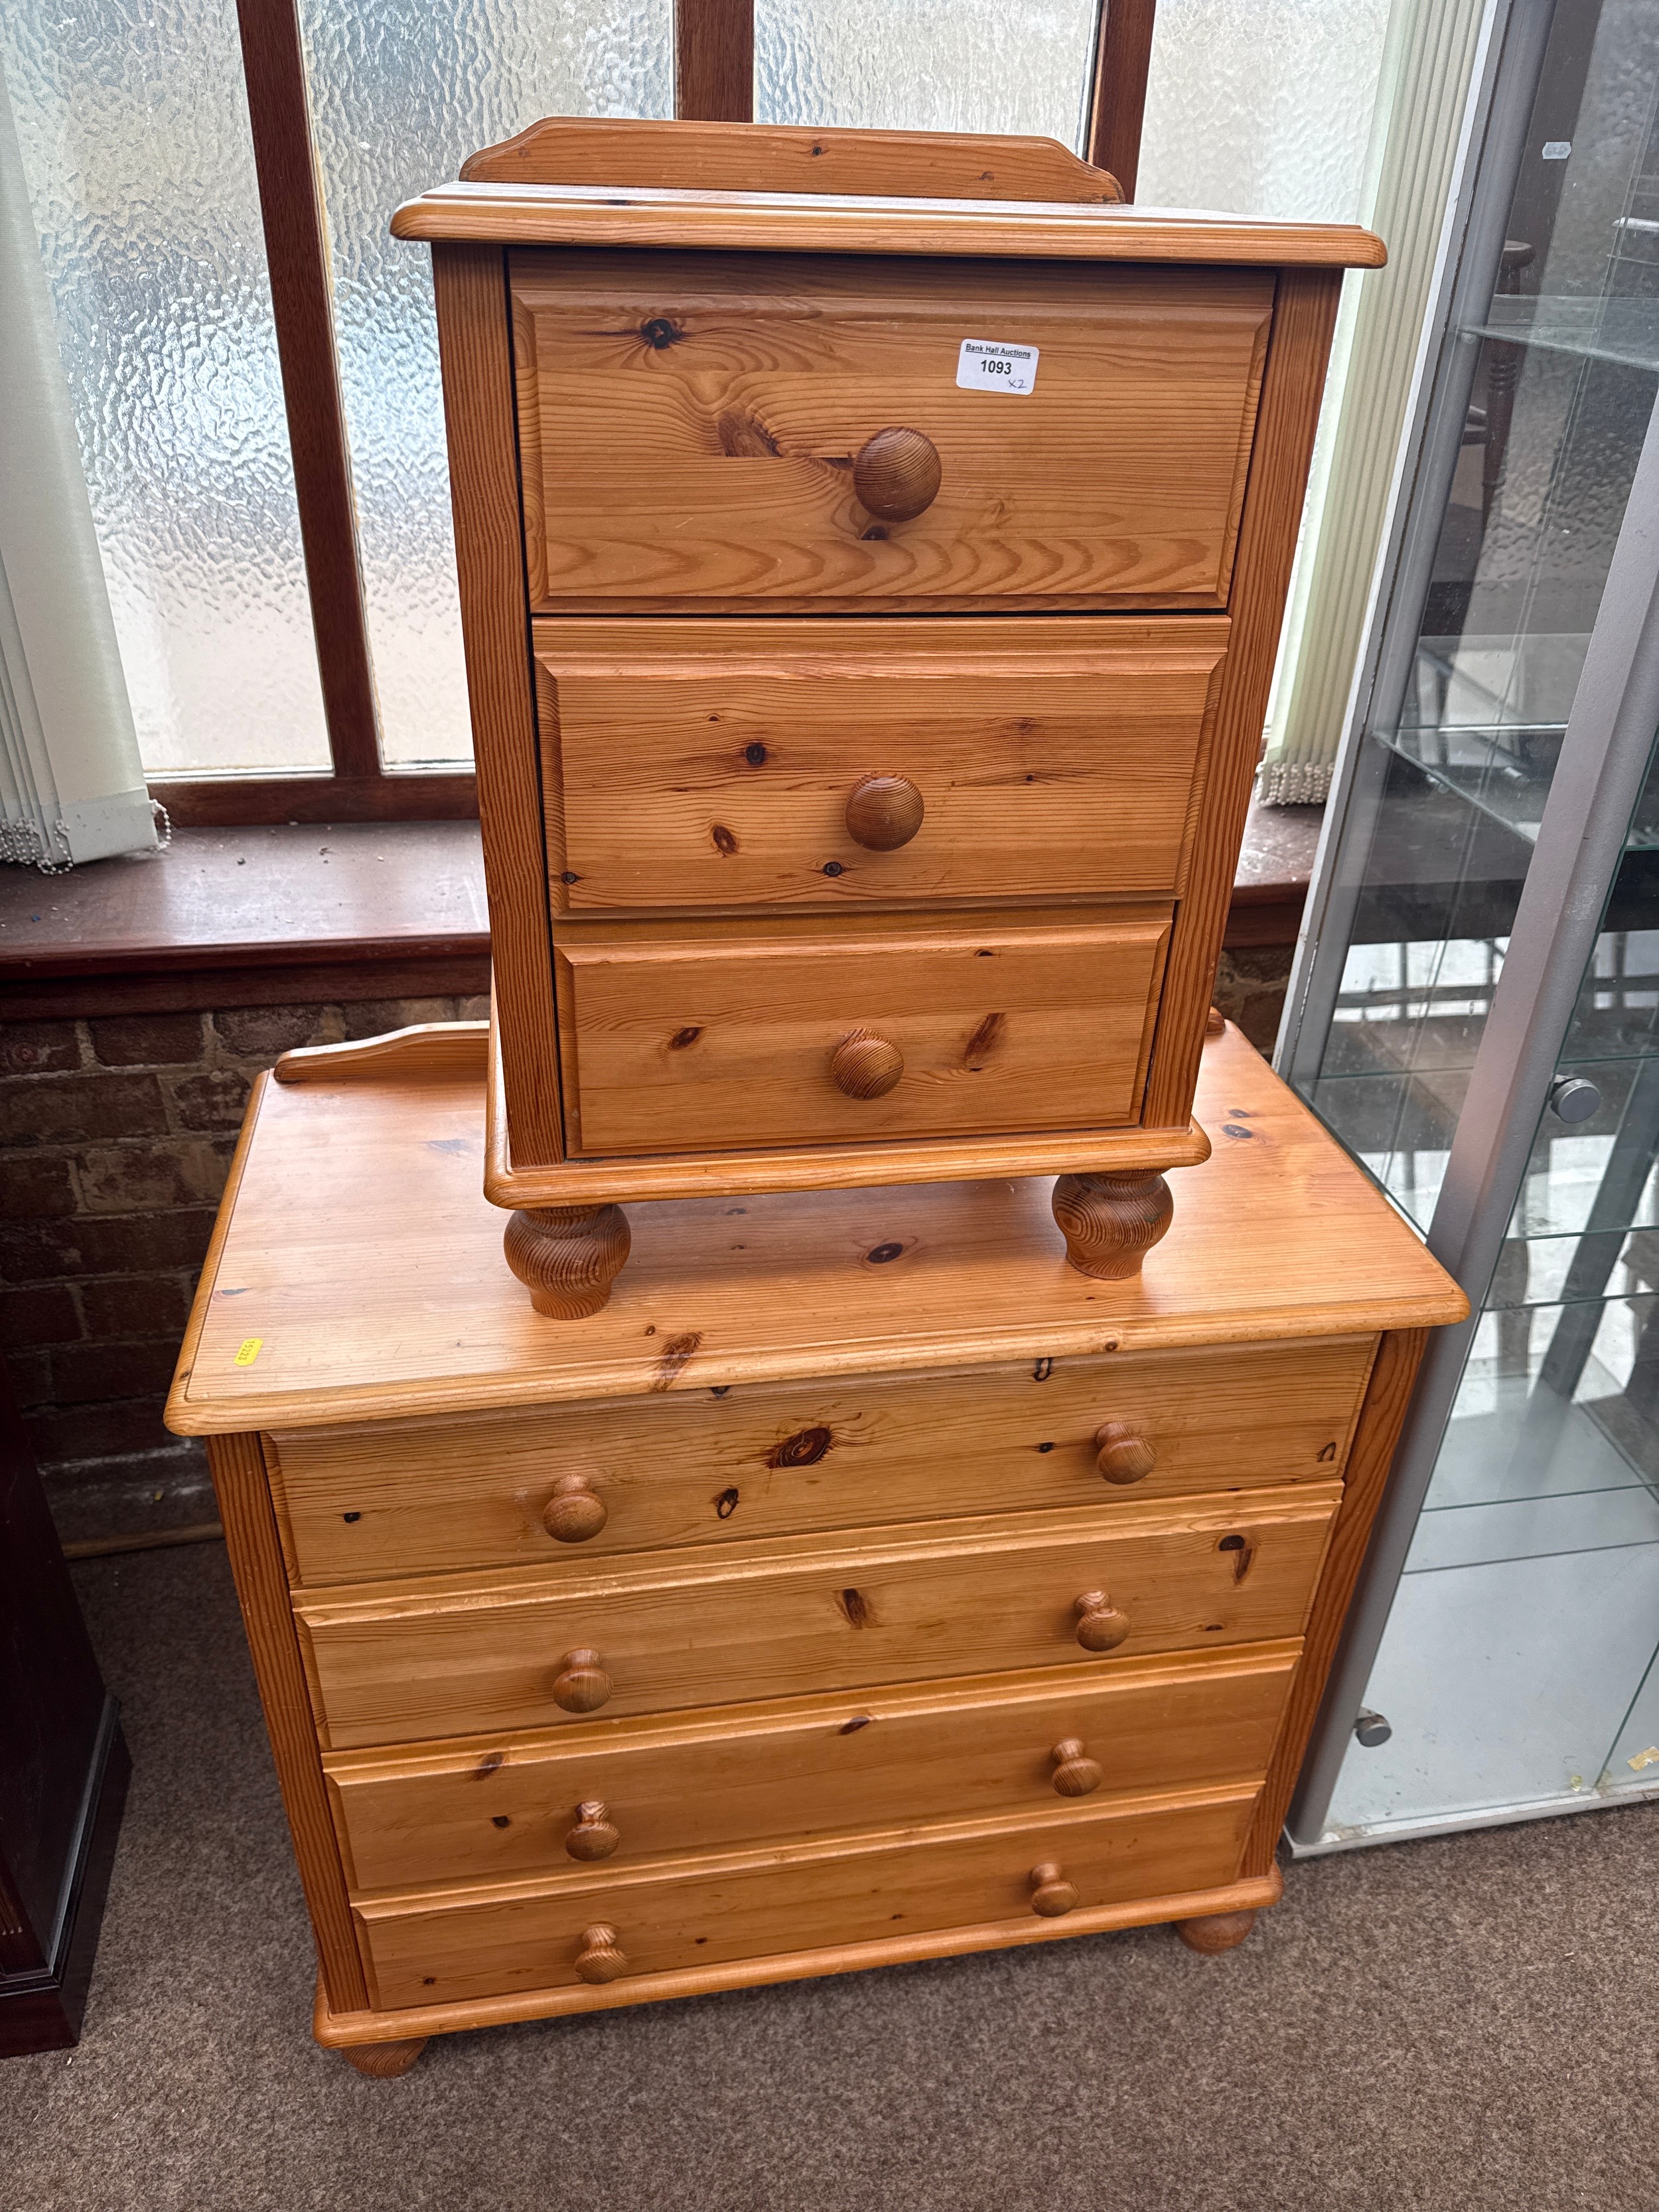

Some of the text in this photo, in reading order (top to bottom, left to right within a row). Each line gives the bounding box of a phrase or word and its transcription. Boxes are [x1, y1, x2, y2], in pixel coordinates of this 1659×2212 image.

[966, 343, 983, 352] Bank
[1000, 348, 1031, 358] Auctions
[981, 359, 1012, 375] 1093
[238, 1341, 255, 1360] 15223
